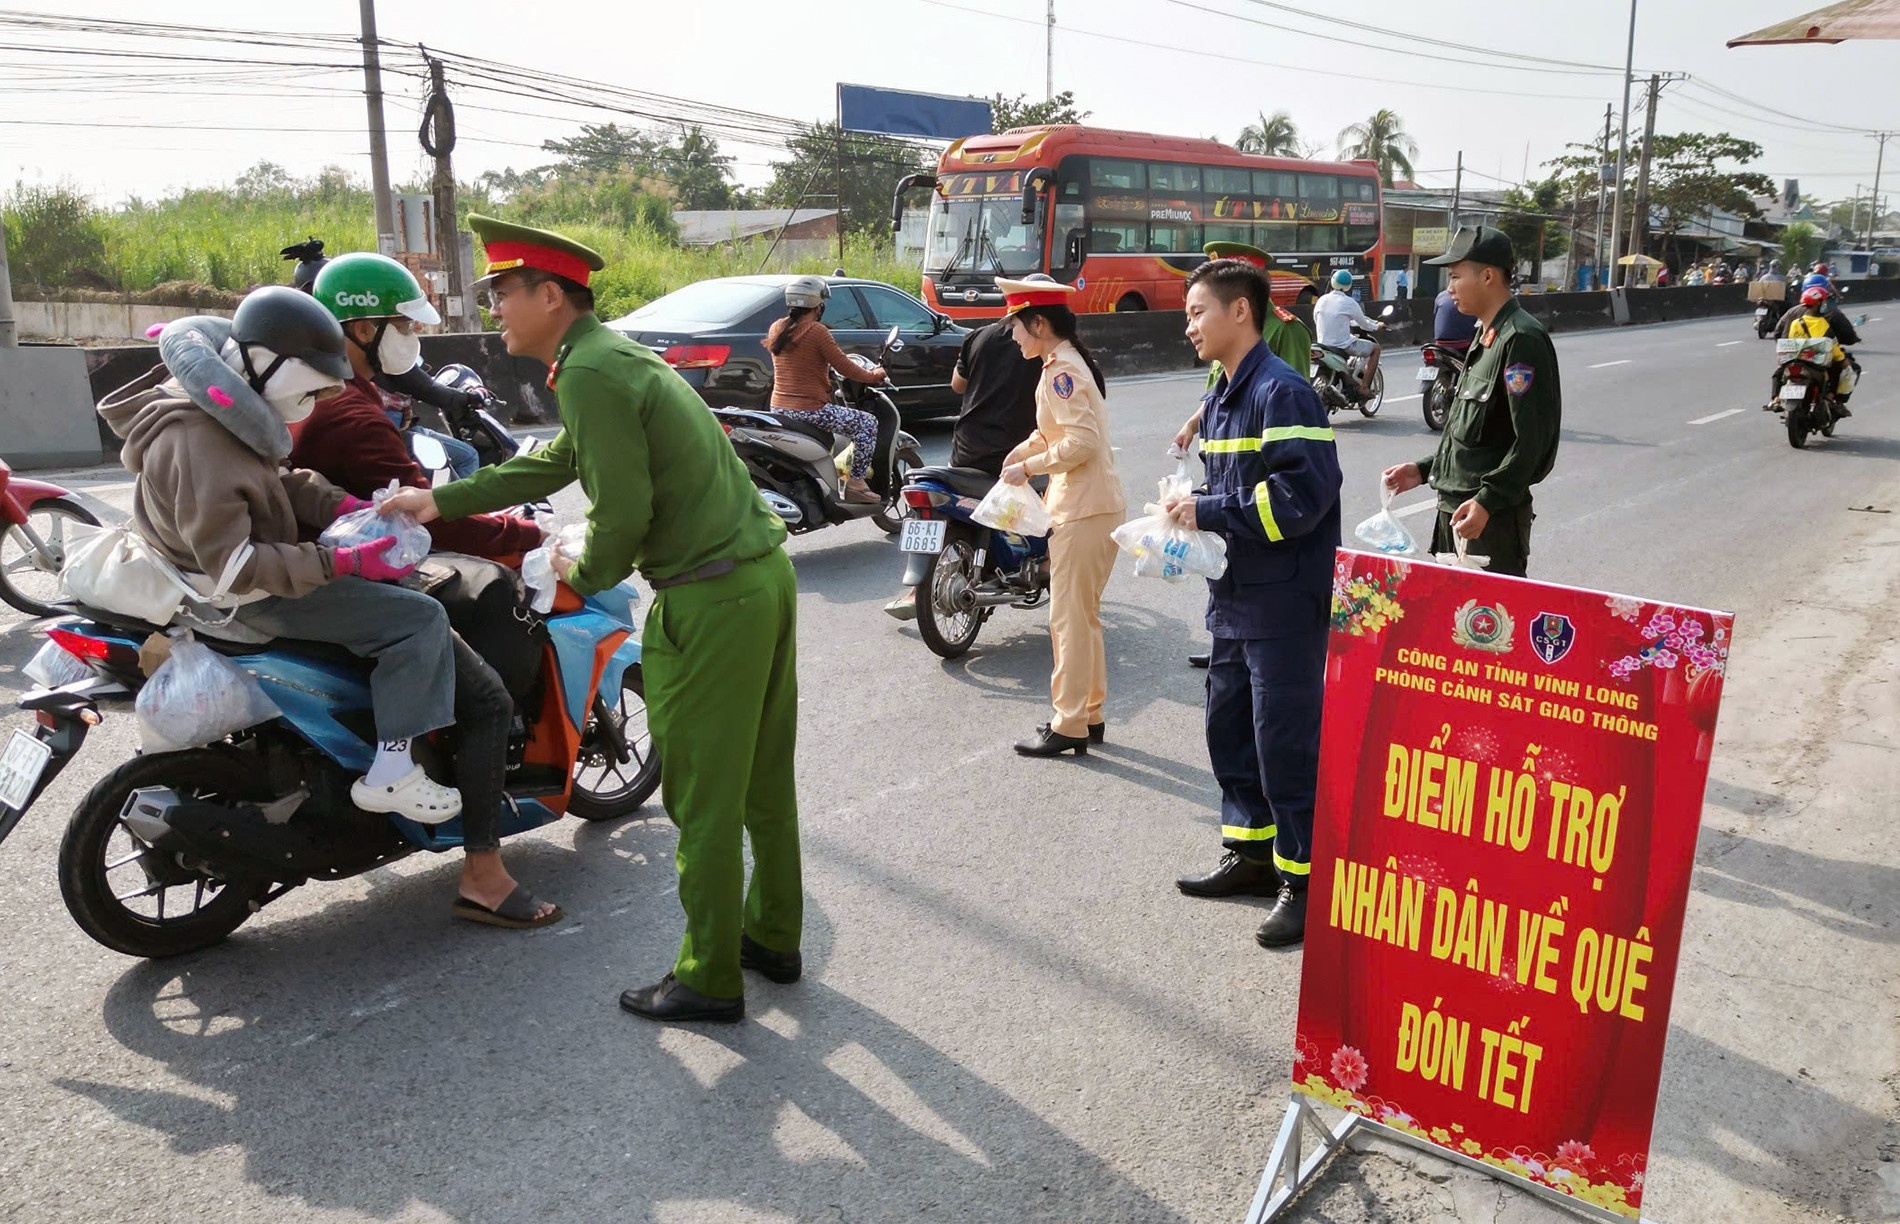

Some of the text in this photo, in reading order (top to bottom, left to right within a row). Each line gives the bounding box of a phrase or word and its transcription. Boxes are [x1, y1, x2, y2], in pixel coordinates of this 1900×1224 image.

[1213, 196, 1298, 219] ÚT VÂN
[335, 290, 380, 307] Grab
[905, 536, 937, 551] 0685
[907, 521, 938, 536] 66-K1
[1398, 646, 1638, 710] CÔNG AN TỈNH VĨNH LONG
[1376, 668, 1658, 740] PHÒNG CẢNH SÁT GIAO THÔNG
[382, 739, 408, 752] 123
[1384, 723, 1626, 890] ĐIỂM HỖ TRỢ
[1330, 856, 1653, 1021] NHÂN DÂN VỀ QUÊ
[1397, 997, 1542, 1113] ĐÓN TẾT
